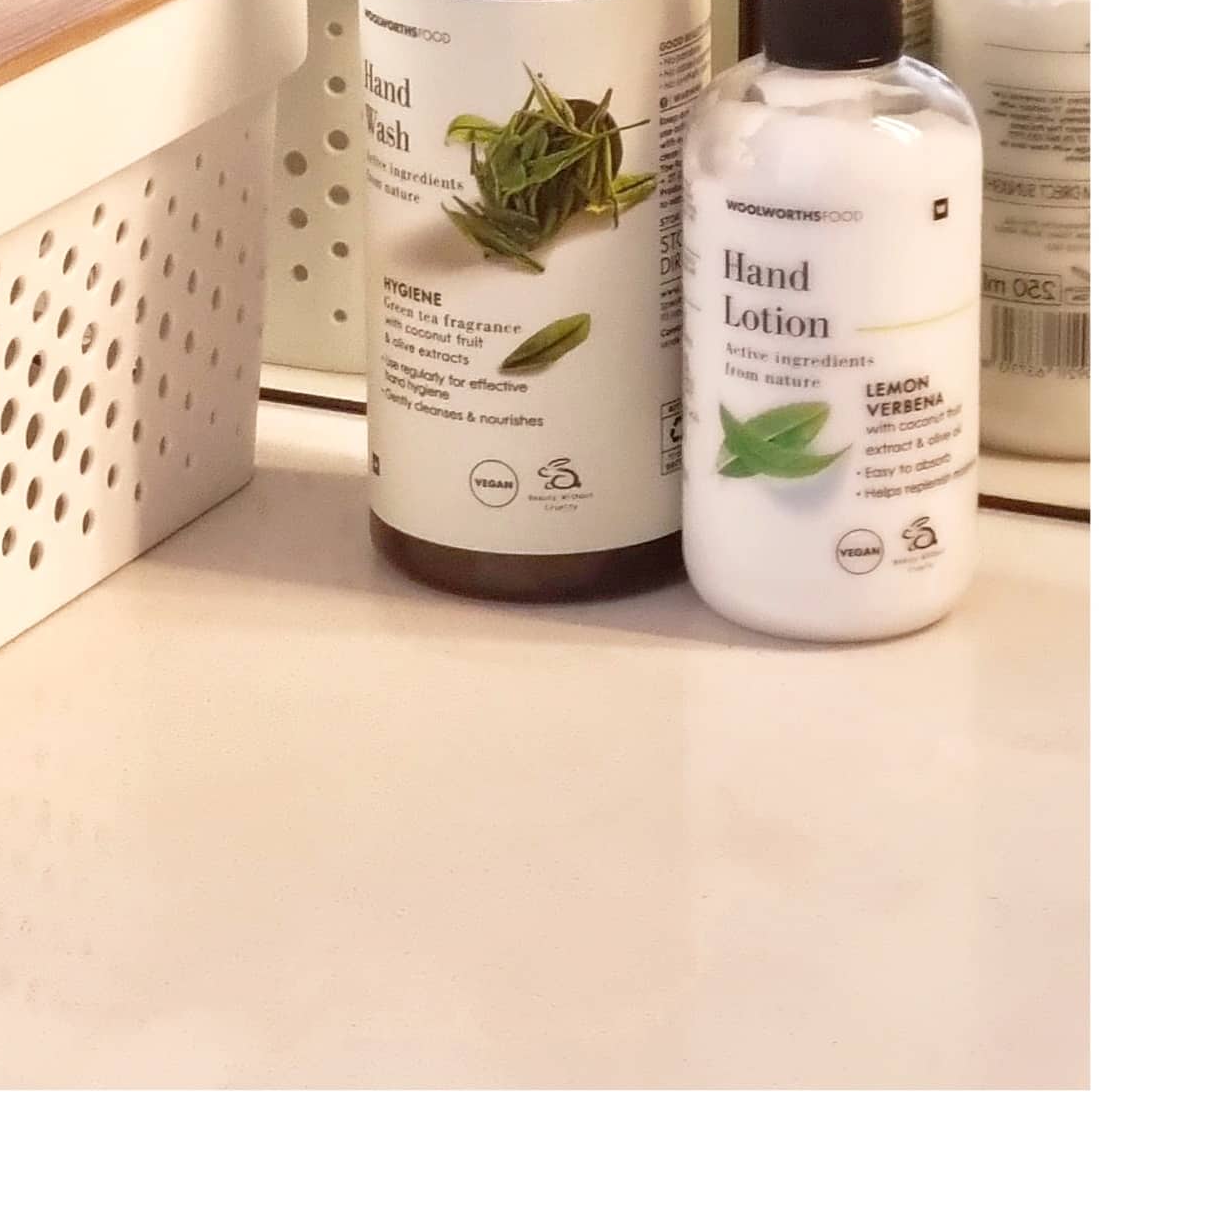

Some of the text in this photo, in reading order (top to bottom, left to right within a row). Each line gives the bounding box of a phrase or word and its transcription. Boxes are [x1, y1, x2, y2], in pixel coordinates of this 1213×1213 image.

[364, 58, 411, 109] Hand
[389, 163, 464, 191] ingredients
[725, 199, 864, 224] WOOLWORTHSFOOD
[723, 248, 811, 293] Hand
[383, 276, 443, 308] HYGIENE
[383, 296, 522, 335] Green tea fragrance
[723, 294, 831, 338] Lotion
[404, 324, 452, 344] coconut
[456, 333, 484, 349] fruit
[418, 347, 470, 366] extracts
[725, 341, 875, 370] Active ingredients
[448, 374, 467, 389] for
[469, 377, 529, 394] effective
[725, 361, 822, 389] from nature
[865, 374, 930, 399] LEMON
[406, 380, 450, 401] hygiene
[413, 400, 464, 422] cleanses
[466, 410, 477, 423] &
[479, 413, 545, 428] nourishes
[865, 391, 945, 418] VERBENA
[865, 421, 897, 436] with
[865, 440, 914, 457] extract
[916, 437, 925, 449] &
[473, 478, 515, 490] VEGAN
[864, 466, 897, 479] Easy
[898, 464, 914, 474] to
[864, 486, 903, 499] Helps
[839, 546, 882, 558] VEGAN
